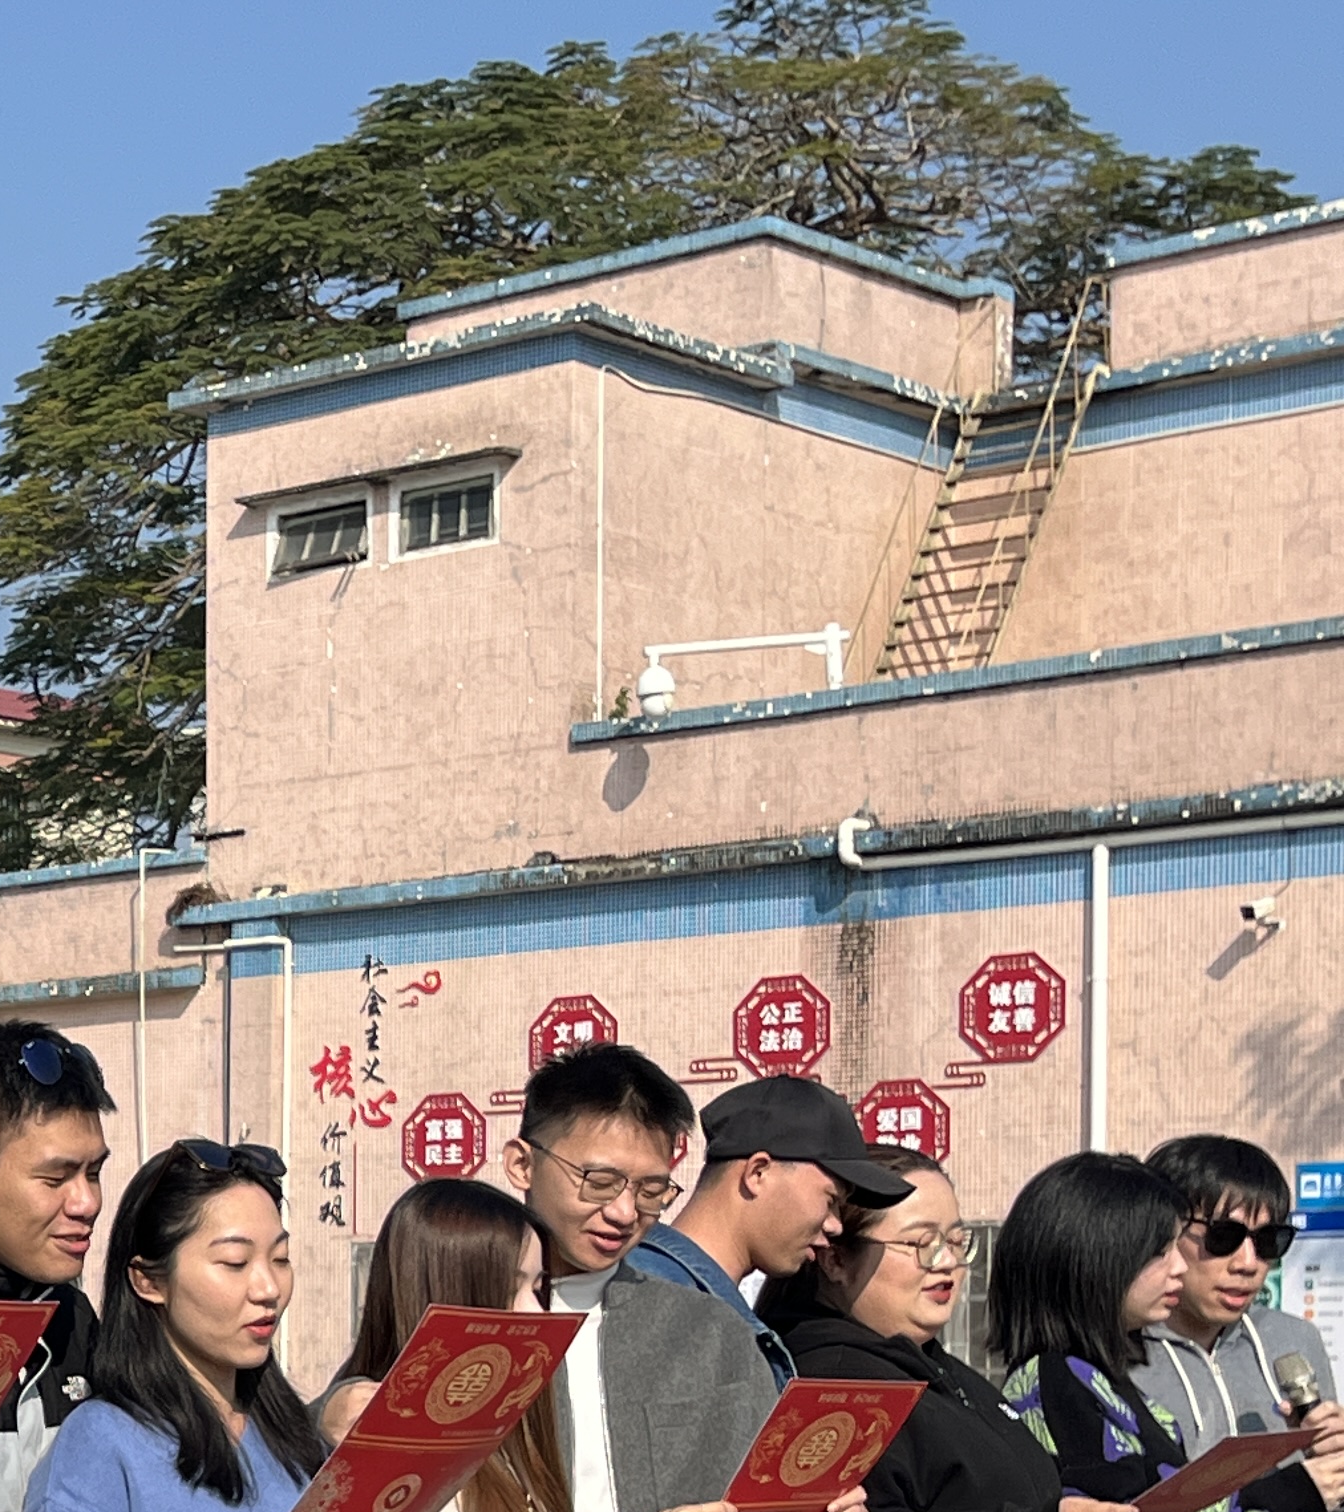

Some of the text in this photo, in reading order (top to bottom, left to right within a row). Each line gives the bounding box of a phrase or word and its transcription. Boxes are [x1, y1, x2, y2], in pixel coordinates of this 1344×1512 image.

[988, 980, 1036, 1006] 诚信
[360, 954, 389, 1084] 社会主义
[759, 1001, 804, 1026] 公正
[988, 1008, 1036, 1033] 友善
[553, 1019, 594, 1045] 文明
[759, 1027, 804, 1052] 法治
[309, 1046, 398, 1131] 核心
[424, 1118, 464, 1142] 富强
[876, 1106, 923, 1132] 爱国
[424, 1144, 464, 1167] 民主
[318, 1122, 347, 1226] 价值观
